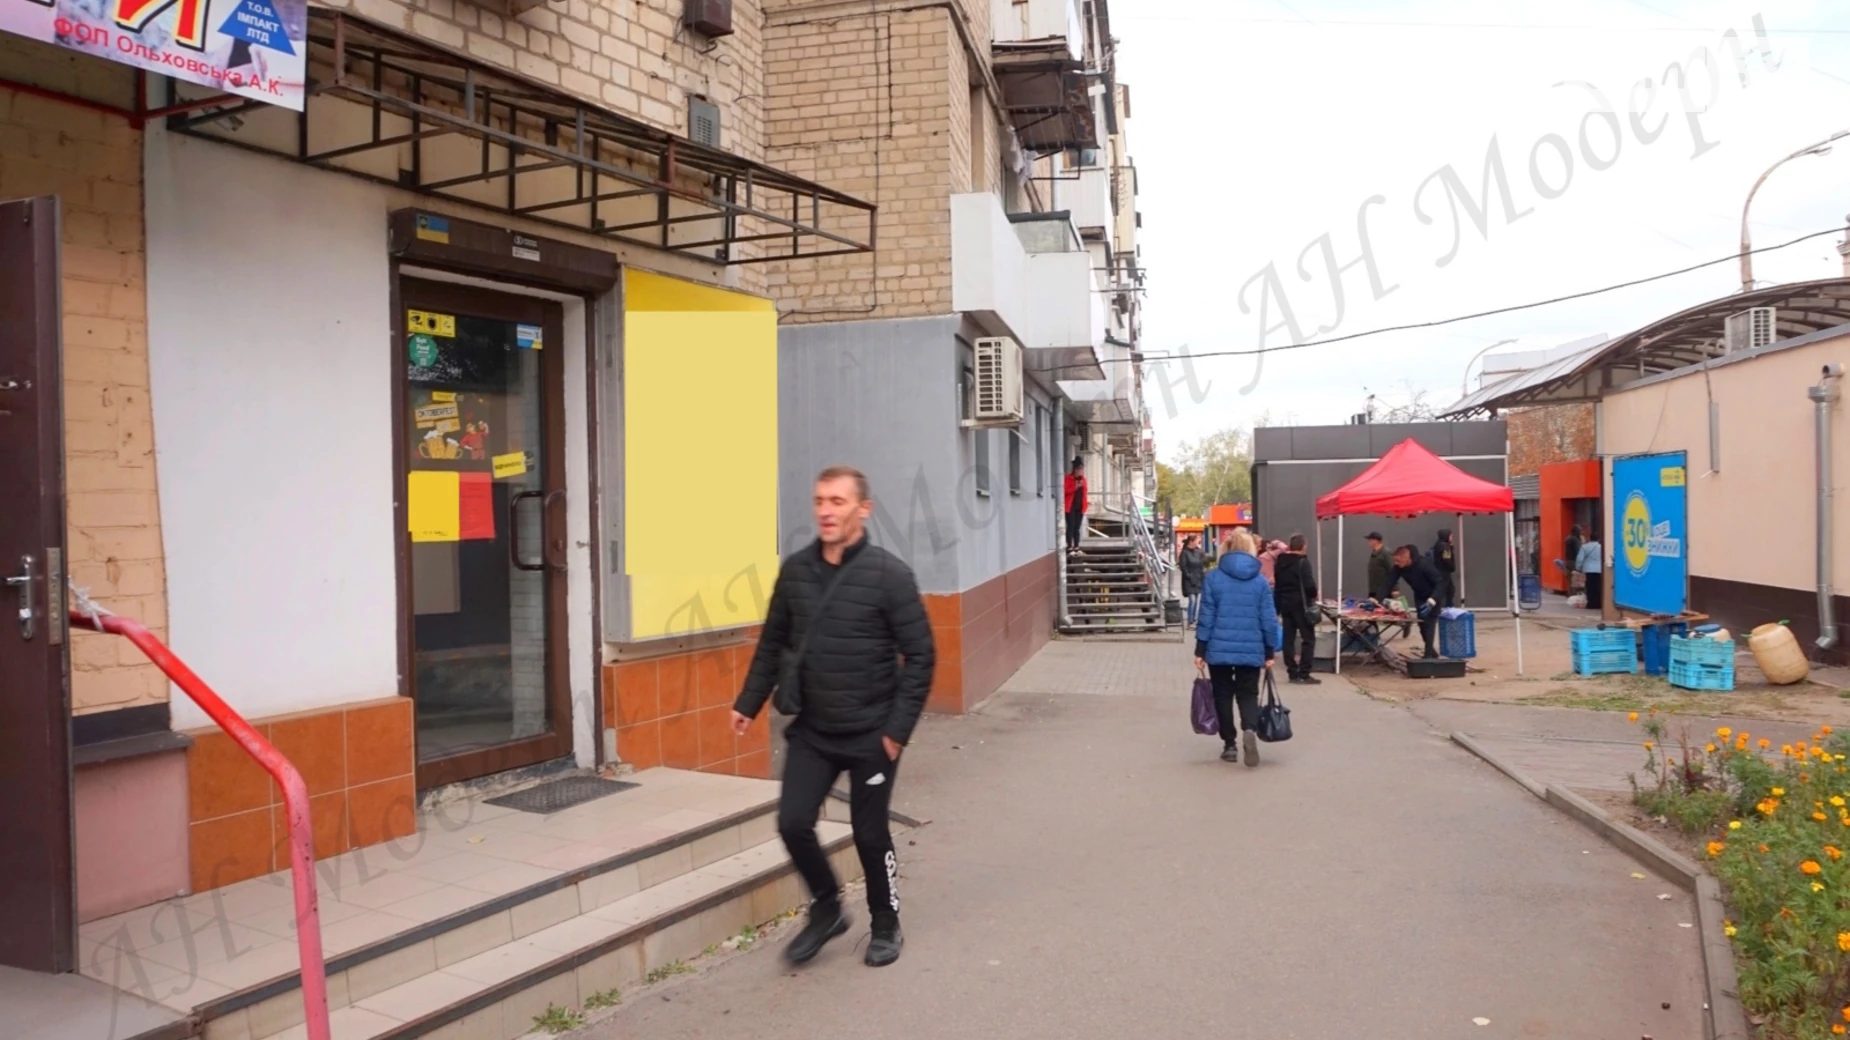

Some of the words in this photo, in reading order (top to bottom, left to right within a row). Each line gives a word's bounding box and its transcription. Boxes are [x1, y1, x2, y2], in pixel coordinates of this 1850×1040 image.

[237, 11, 280, 33] ІМПАКТ
[246, 27, 270, 45] ЛТД
[54, 17, 109, 47] ФОП
[116, 34, 243, 88] Ольховська
